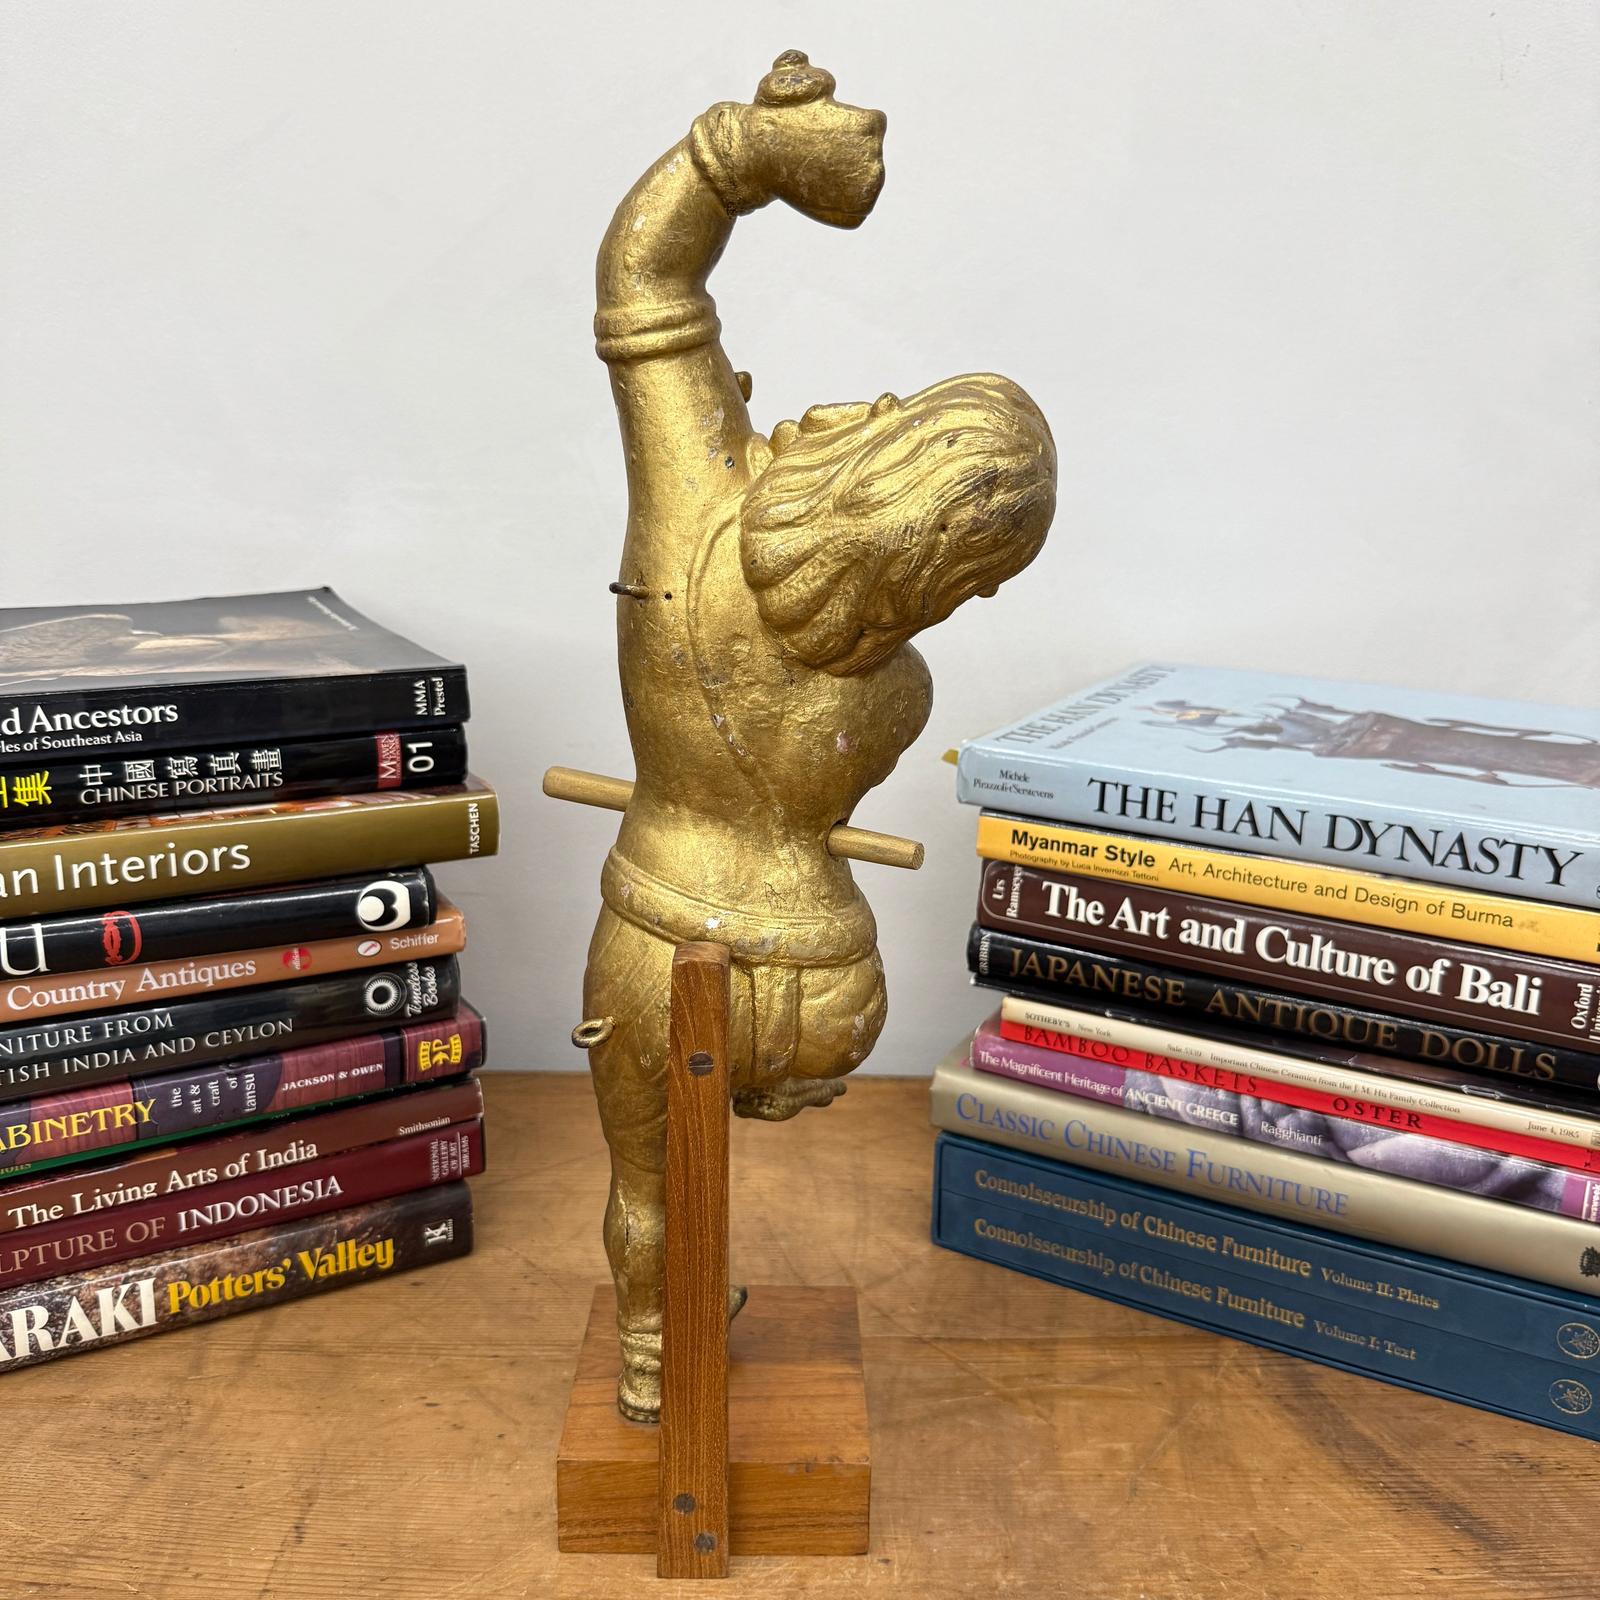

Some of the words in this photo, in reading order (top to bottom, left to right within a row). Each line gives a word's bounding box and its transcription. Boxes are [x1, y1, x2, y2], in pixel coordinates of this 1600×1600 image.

[414, 679, 428, 716] MMA
[432, 676, 446, 716] Prestel
[0, 706, 24, 736] d
[29, 703, 179, 734] Ancestors
[993, 720, 1062, 744] THE
[1041, 703, 1106, 726] HAN
[0, 740, 21, 753] les
[24, 737, 39, 751] of
[42, 734, 112, 750] Southeast
[115, 730, 143, 743] Asia
[406, 741, 435, 773] 01
[80, 782, 169, 805] CHINESE
[175, 771, 284, 796] PORTRAITS
[468, 802, 480, 855] TASCHEN
[1087, 777, 1178, 825] THE
[1190, 794, 1310, 846] HAN
[1323, 813, 1585, 886] DYNASTY
[55, 842, 251, 891] Interiors
[1010, 850, 1058, 866] Photography
[1060, 858, 1070, 868] by
[1011, 829, 1099, 859] Myanmar
[1104, 844, 1156, 869] Style
[1168, 857, 1197, 877] Art,
[1203, 862, 1308, 894] Architecture
[1314, 884, 1348, 900] and
[1354, 887, 1419, 914] Design
[1426, 900, 1445, 916] of
[1451, 903, 1514, 928] Burma
[992, 878, 1006, 900] Urs
[389, 933, 440, 951] Schiffer
[1041, 880, 1106, 926] The
[1108, 896, 1172, 940] Art
[1178, 917, 1246, 955] and
[1255, 925, 1397, 986] Culture
[1405, 957, 1452, 997] of
[1454, 962, 1543, 1016] Bali
[7, 978, 127, 1011] Country
[136, 959, 257, 993] Antiques
[405, 961, 422, 1018] Timeless
[421, 965, 438, 1007] Books
[104, 1012, 175, 1039] FROM
[1009, 948, 1186, 1006] JAPANESE
[1204, 988, 1400, 1049] ANTIQUE
[1418, 1028, 1557, 1081] DOLLS
[1570, 982, 1594, 1030] Oxford
[63, 1048, 137, 1074] INDIA
[144, 1037, 196, 1060] AND
[205, 1018, 294, 1048] CEYLON
[171, 1087, 182, 1108] the
[208, 1079, 221, 1107] craft
[226, 1075, 238, 1089] of
[243, 1073, 257, 1113] tansu
[281, 1072, 335, 1092] JACKSON
[338, 1070, 348, 1080] &
[351, 1063, 384, 1078] OWEN
[1024, 1025, 1130, 1063] BAMBOO
[1144, 1053, 1257, 1093] BASKETS
[1333, 1097, 1422, 1129] OSTER
[191, 1097, 202, 1114] art
[979, 1050, 1000, 1066] The
[1000, 1056, 1063, 1083] Magnificent
[1064, 1072, 1111, 1096] Heritage
[1111, 1085, 1125, 1097] of
[1125, 1087, 1186, 1111] ANCIENT
[1186, 1102, 1239, 1127] GREECE
[1260, 1120, 1323, 1147] Ragghianti
[1389, 1091, 1417, 1106] Family
[1418, 1098, 1461, 1114] Collection
[399, 1115, 452, 1136] Smithsonian
[1526, 1120, 1547, 1133] June
[956, 1092, 1055, 1141] CLASSIC
[1063, 1119, 1177, 1173] CHINESE
[1185, 1147, 1350, 1217] FURNITURE
[8, 1203, 64, 1229] The
[72, 1181, 158, 1216] Living
[165, 1167, 218, 1194] Arts
[225, 1153, 250, 1178] of
[257, 1139, 319, 1172] India
[125, 1216, 166, 1243] OF
[177, 1175, 344, 1233] INDONESIA
[974, 1169, 1117, 1227] Connoisseurship
[1120, 1210, 1141, 1230] of
[1142, 1214, 1218, 1251] Chinese
[1221, 1234, 1313, 1277] Furniture
[1320, 1266, 1374, 1293] Volume
[1397, 1286, 1441, 1310] Plates
[166, 1256, 292, 1315] Potters'
[298, 1236, 395, 1282] Valley
[974, 1217, 1116, 1278] Connoisseurship
[1118, 1262, 1139, 1279] of
[1139, 1265, 1213, 1301] Chinese
[1215, 1286, 1306, 1329] Furniture
[1313, 1319, 1367, 1346] Volume
[1383, 1339, 1417, 1361] Text
